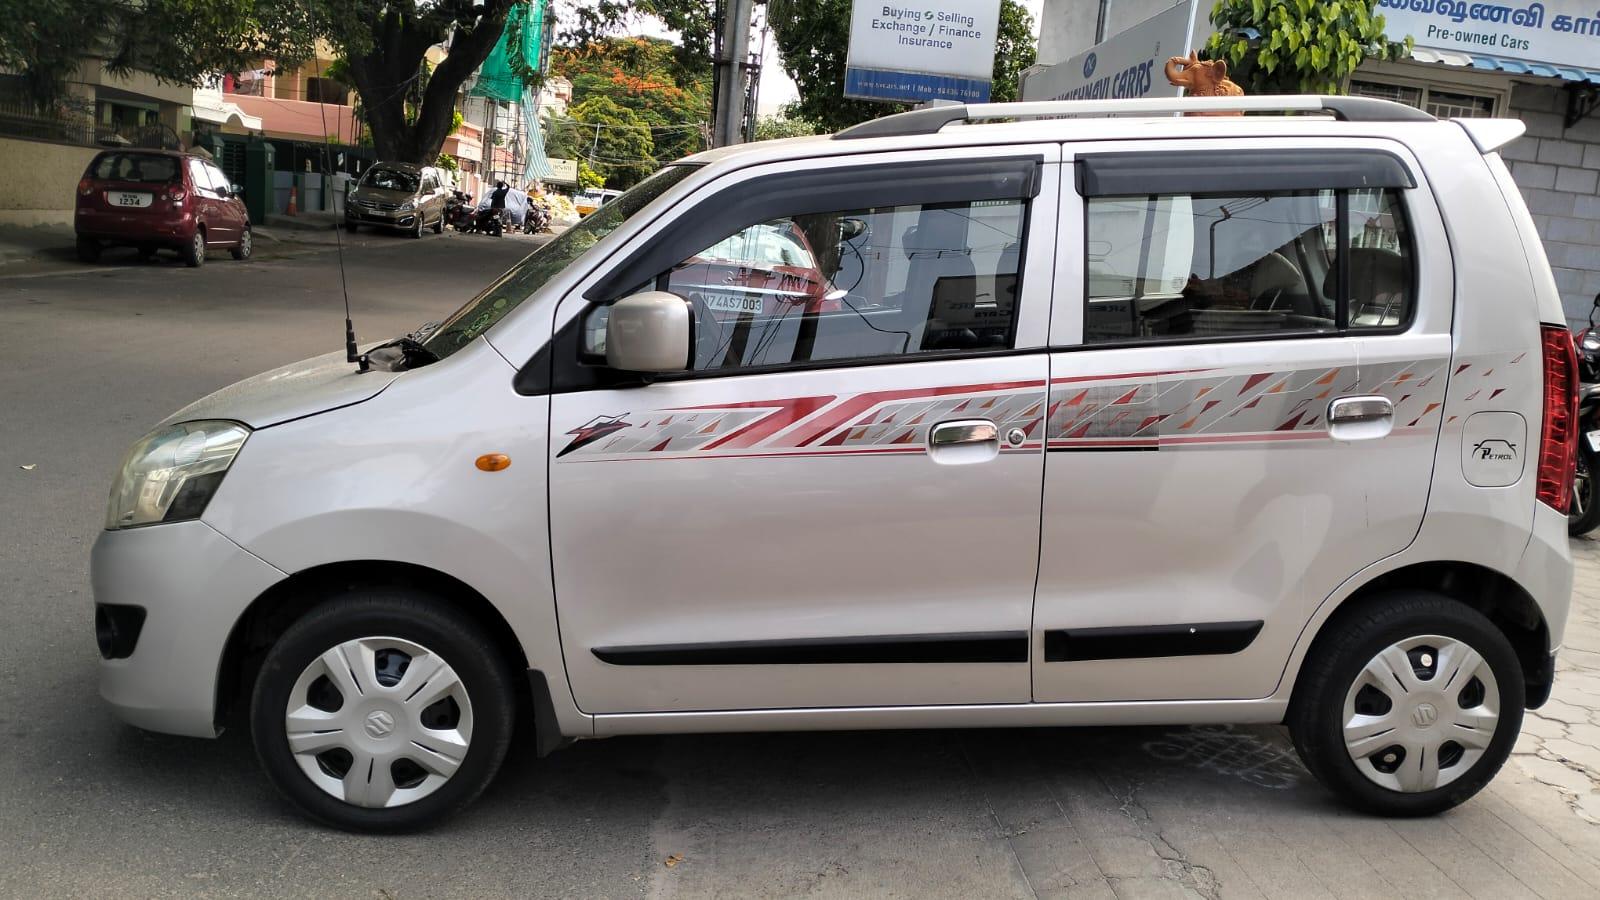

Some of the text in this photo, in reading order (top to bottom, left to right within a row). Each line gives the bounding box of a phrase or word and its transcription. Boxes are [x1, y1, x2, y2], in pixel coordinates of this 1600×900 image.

[882, 6, 974, 27] Buying Selling
[872, 19, 926, 34] Exchange
[939, 25, 981, 39] Finance
[1427, 24, 1530, 50] Pre-owned Cars
[898, 35, 953, 49] Insurance
[1112, 58, 1154, 99] CARRS
[119, 198, 140, 206] 1234
